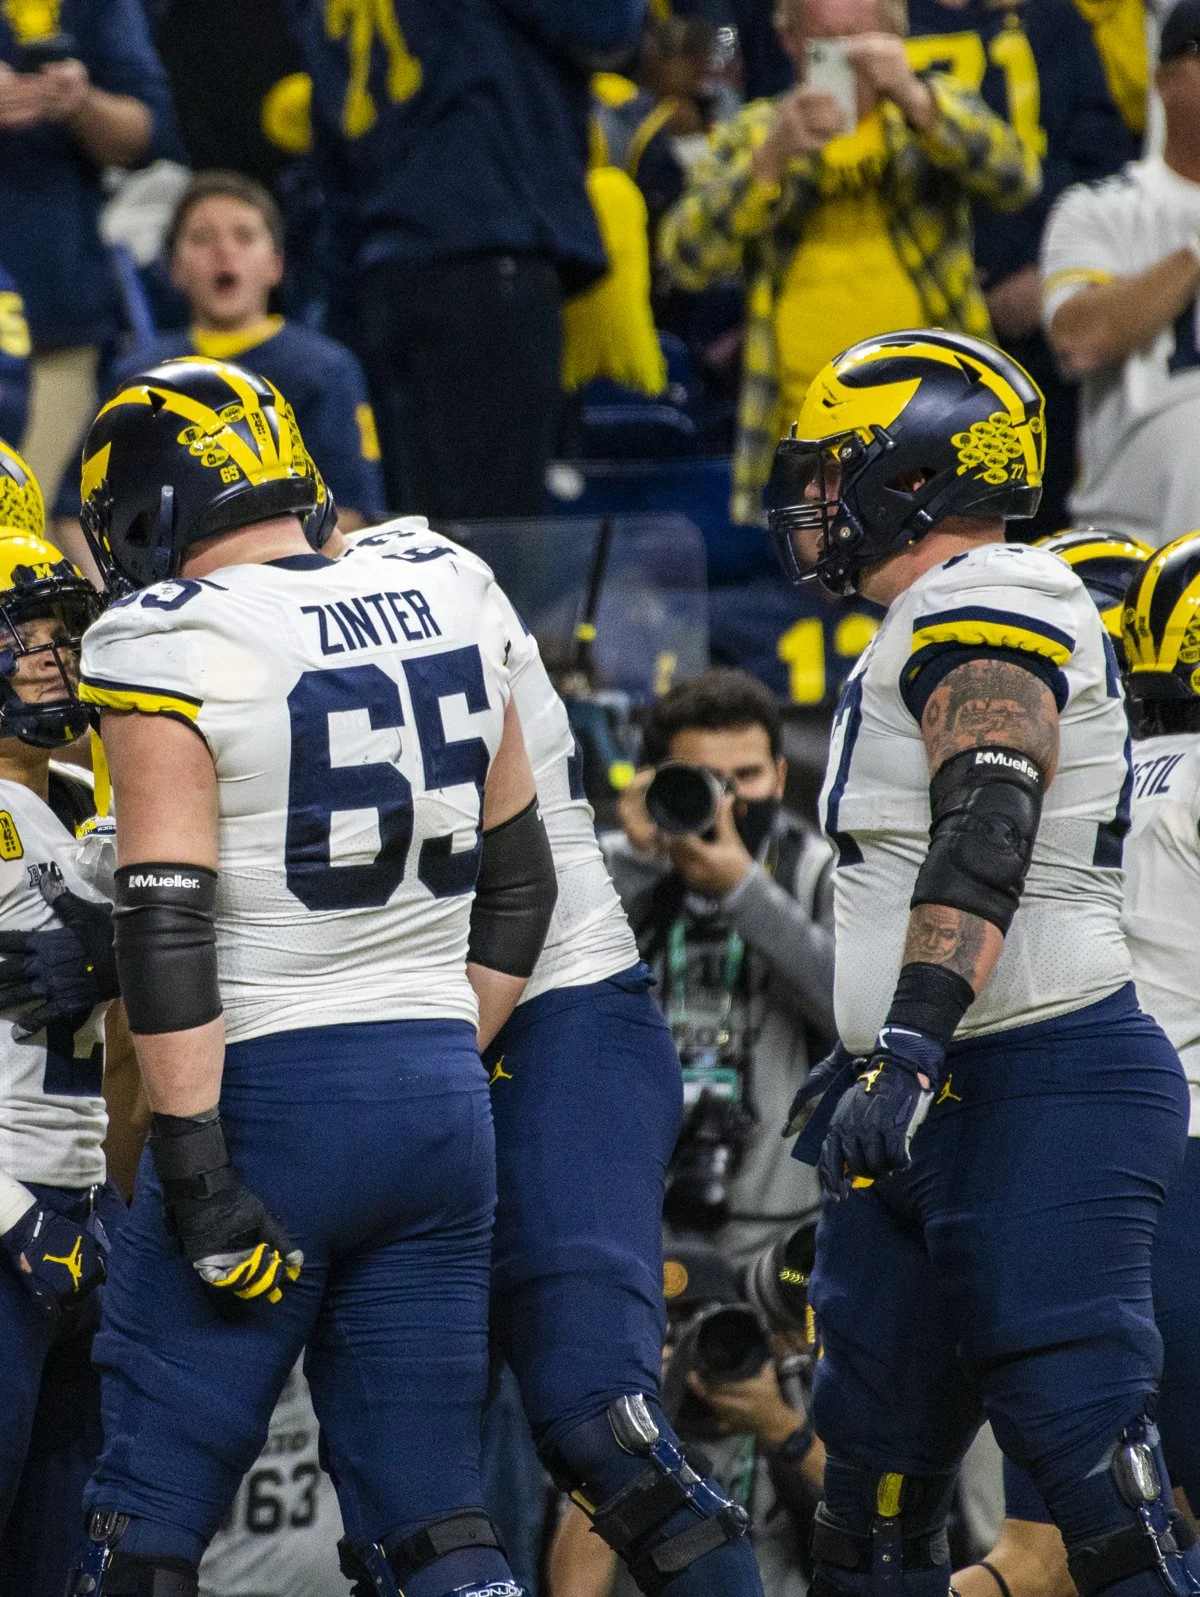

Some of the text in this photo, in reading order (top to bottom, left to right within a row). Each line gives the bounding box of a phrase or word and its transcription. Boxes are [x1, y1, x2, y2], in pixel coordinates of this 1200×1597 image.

[220, 465, 240, 483] 65
[1011, 463, 1025, 479] 77
[32, 563, 54, 579] M
[300, 589, 442, 655] ZINTER
[284, 644, 492, 911] 65
[246, 1462, 320, 1534] 63
